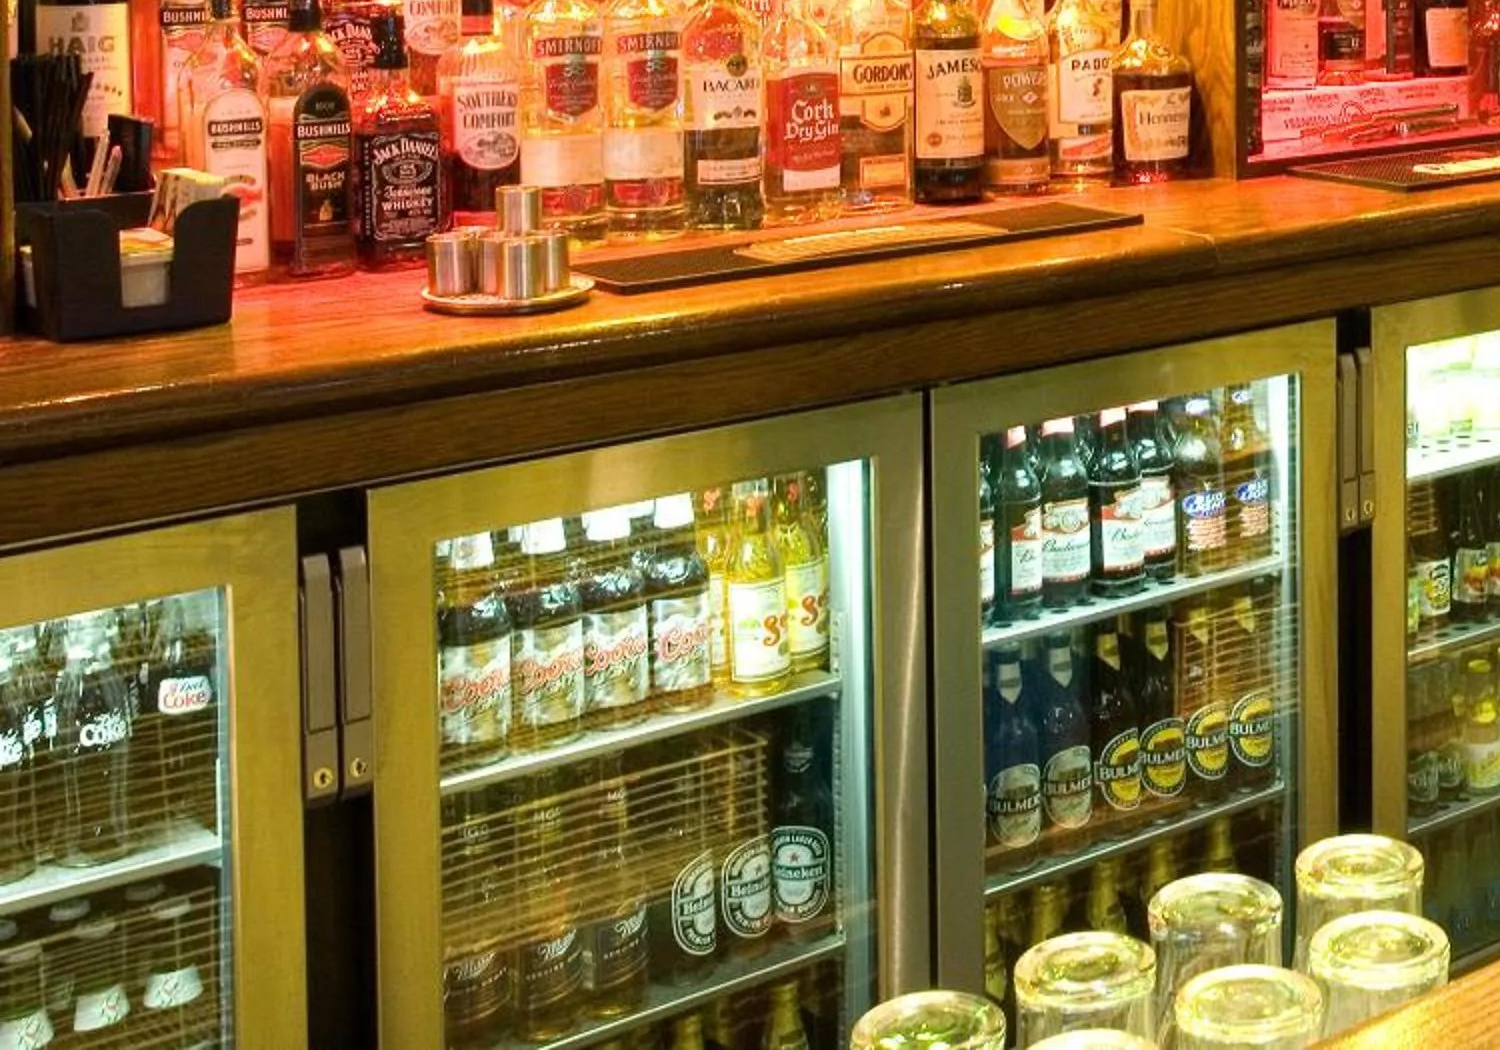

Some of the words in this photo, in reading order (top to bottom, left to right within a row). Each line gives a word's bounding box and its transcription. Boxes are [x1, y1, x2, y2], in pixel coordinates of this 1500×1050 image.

[162, 9, 206, 24] BUSHMI
[48, 35, 116, 54] HAIG
[1070, 56, 1111, 72] PADD
[791, 100, 834, 123] Cork
[783, 122, 813, 142] Dry
[813, 122, 839, 141] Gin
[162, 690, 207, 710] Coke
